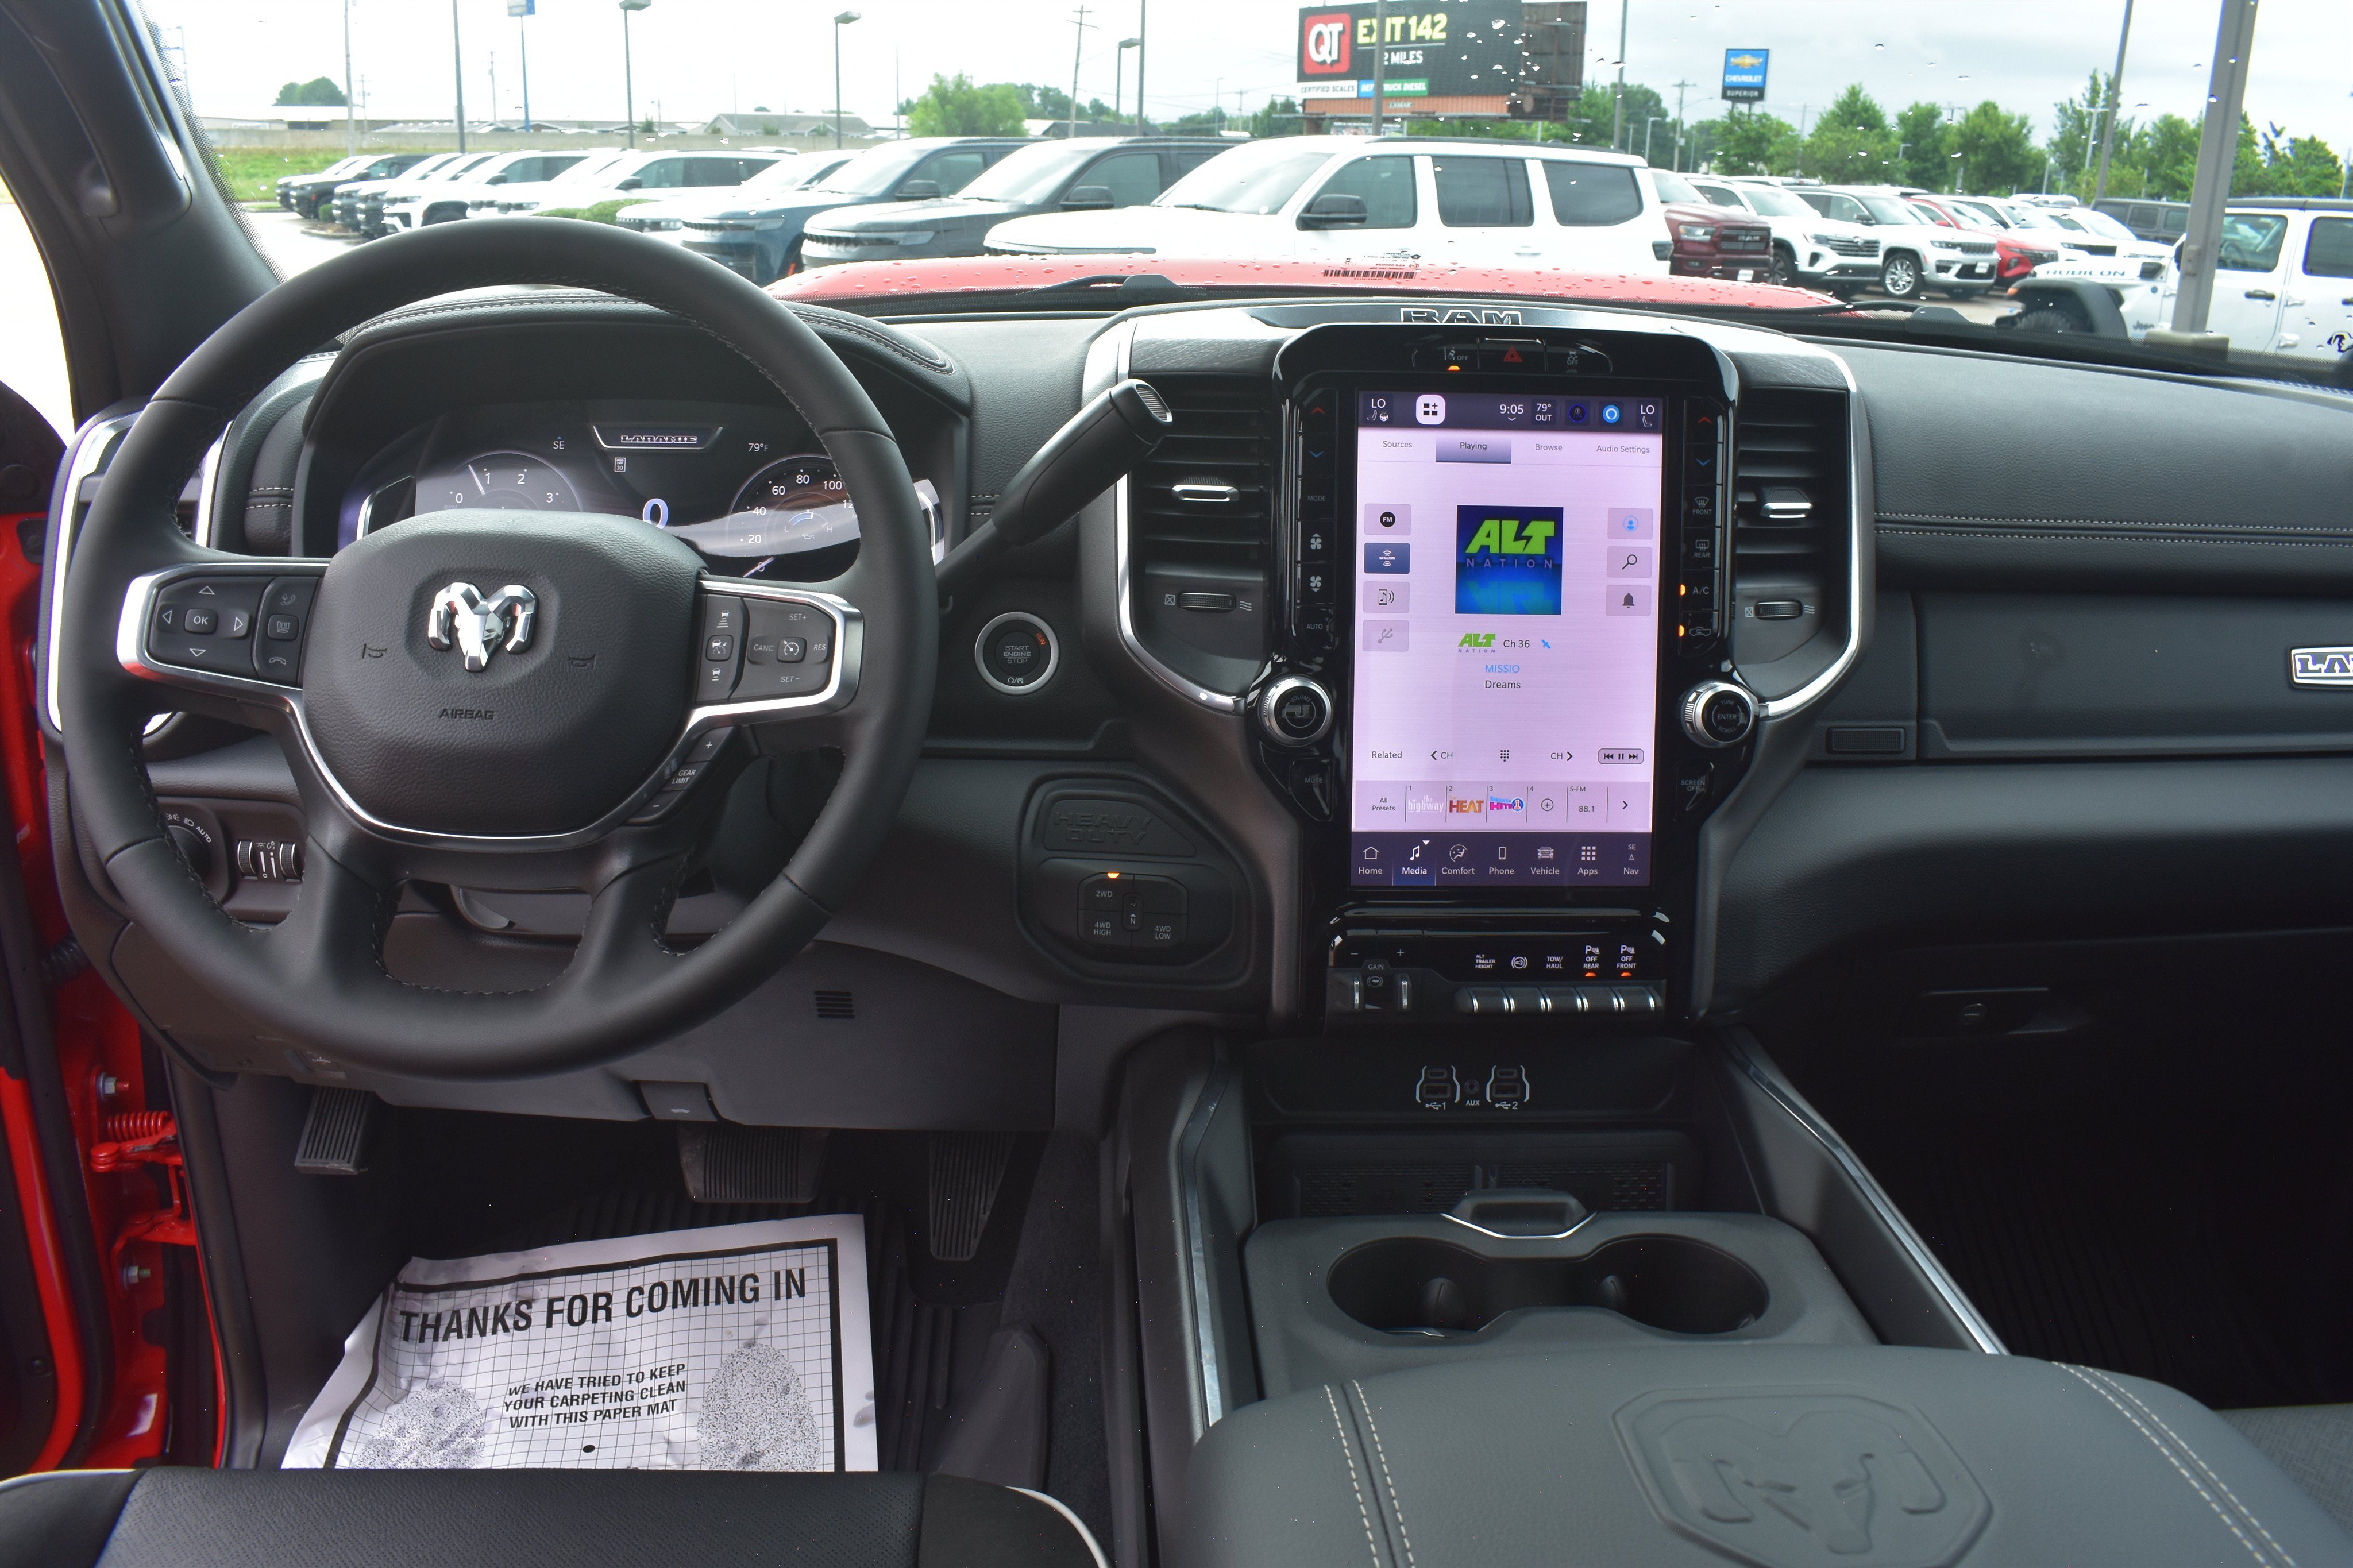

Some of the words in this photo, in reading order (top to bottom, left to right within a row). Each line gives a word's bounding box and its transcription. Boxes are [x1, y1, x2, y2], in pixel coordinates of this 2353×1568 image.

[1409, 13, 1448, 41] 142
[1308, 22, 1344, 64] QT
[1391, 51, 1424, 65] MILES
[1403, 82, 1426, 91] DIESEL
[1400, 308, 1522, 325] RAM
[1371, 398, 1386, 408] LO
[1536, 403, 1552, 412] 79°
[1499, 404, 1523, 415] 9:05
[1641, 404, 1655, 415] LO
[620, 435, 697, 443] LARAMIE
[553, 441, 565, 450] SE
[1382, 441, 1413, 449] Sources
[1460, 441, 1487, 451] Playing
[1620, 446, 1650, 454] Settings
[485, 473, 491, 484] 1
[517, 473, 525, 485] 2
[796, 474, 810, 484] 80
[772, 486, 786, 495] 60
[823, 481, 843, 491] 100
[455, 493, 463, 504] 0
[546, 492, 554, 503] 3
[843, 499, 854, 509] 12
[642, 498, 669, 530] 0
[753, 507, 766, 516] 40
[748, 534, 762, 543] 20
[1465, 520, 1554, 554] ALT
[1466, 558, 1552, 569] NATION
[1692, 587, 1709, 595] A/C
[194, 616, 209, 625] OK
[1036, 632, 1046, 646] RUN
[1458, 633, 1496, 647] ALT
[1503, 639, 1515, 648] Ch
[1518, 639, 1530, 648] 36
[753, 644, 774, 652] CANC
[813, 643, 826, 651] RES
[1485, 665, 1520, 673] MISSIO
[2295, 654, 2353, 677] LA
[1485, 680, 1521, 689] Dreams
[1290, 695, 1311, 703] VOLUME
[439, 708, 495, 720] AIRBAG
[1371, 751, 1402, 759] Related
[1440, 751, 1453, 759] CH
[678, 768, 696, 777] GEAR
[672, 777, 689, 785] LIMIT
[1408, 799, 1444, 813] highway
[1449, 800, 1484, 813] HEAT
[1053, 811, 1154, 829] HEAVY
[195, 826, 212, 843] AUTO
[1066, 828, 1147, 845] DUTY
[1358, 867, 1383, 875] Home
[1401, 867, 1428, 875] Media
[1441, 866, 1475, 875] Comfort
[1488, 867, 1514, 875] Phone
[1530, 867, 1560, 875] Vehicle
[1577, 867, 1598, 877] Apps
[1442, 1102, 1446, 1110] 1
[400, 1300, 533, 1343] THANKS
[546, 1292, 613, 1329] FOR
[626, 1273, 760, 1318] COMING
[774, 1268, 805, 1301] IN
[508, 1384, 530, 1396] WE
[534, 1377, 573, 1392] HAVE
[577, 1374, 622, 1388] TRIED
[627, 1371, 645, 1384] TO
[650, 1363, 686, 1381] KEEP
[504, 1396, 545, 1412] YOUR
[550, 1389, 634, 1408] CARPETING
[640, 1380, 686, 1400] CLEAN
[510, 1414, 549, 1428] WITH
[555, 1411, 588, 1424] THIS
[593, 1405, 642, 1421] PAPER
[647, 1399, 678, 1416] MAT
